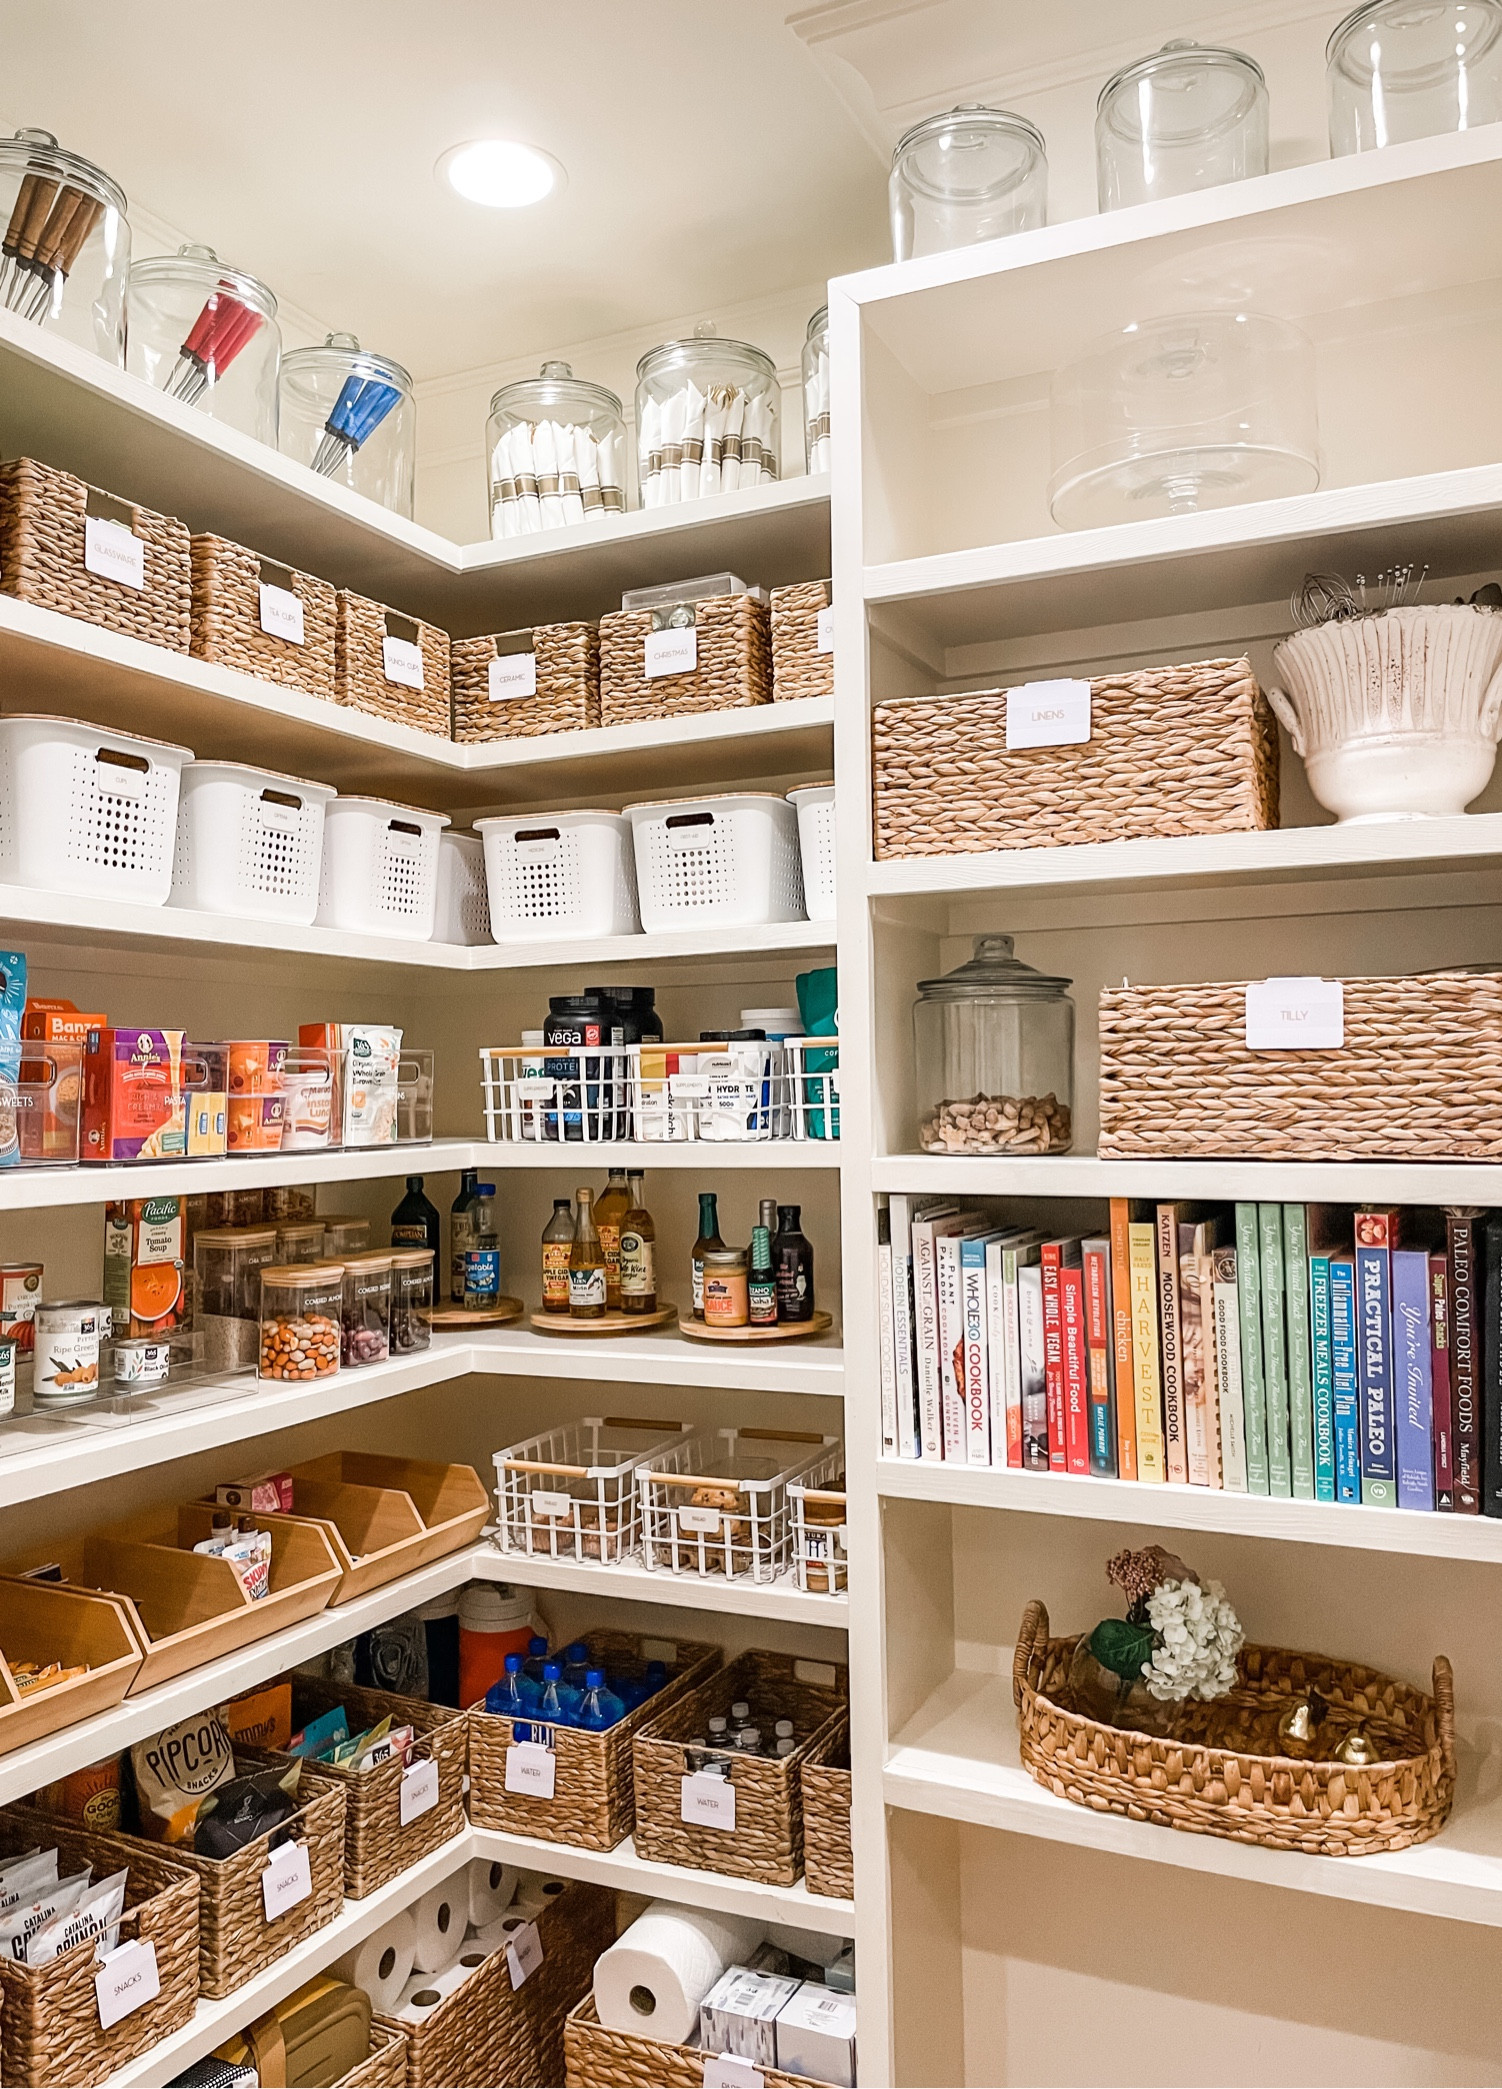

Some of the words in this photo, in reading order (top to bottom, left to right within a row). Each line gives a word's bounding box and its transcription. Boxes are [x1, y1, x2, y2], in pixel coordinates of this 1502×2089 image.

[94, 543, 137, 568] GLASSWARE
[269, 606, 280, 617] TEA
[281, 612, 296, 624] CUPS
[387, 656, 405, 668] PUNCH
[407, 662, 420, 673] CUPS
[653, 648, 689, 660] CHRISTMAS
[499, 673, 526, 684] CERAMIC
[1031, 709, 1065, 722] LINENS
[1280, 1010, 1309, 1021] TILLY
[131, 1053, 161, 1063] Annie's
[546, 1062, 578, 1072] PROTEI
[164, 1096, 187, 1106] PASTA
[144, 1201, 177, 1217] Pacific
[146, 1237, 172, 1246] Tomato
[149, 1244, 168, 1253] Soup
[1116, 1223, 1125, 1270] HOMESTYLE
[1161, 1214, 1171, 1258] KATZEN
[1239, 1223, 1254, 1255] You're
[1262, 1223, 1277, 1255] You're
[1288, 1224, 1302, 1255] You're
[466, 1263, 494, 1272] getable
[920, 1238, 932, 1298] AGAINST
[1453, 1228, 1469, 1282] PALEO
[880, 1252, 889, 1300] HOLIDAY
[895, 1256, 905, 1307] MODERN
[939, 1246, 947, 1305] PARADOX
[1044, 1265, 1058, 1291] EASY.
[1090, 1256, 1099, 1297] METABOLISM
[1243, 1254, 1255, 1290] Invited
[1266, 1255, 1278, 1290] Invited
[1291, 1256, 1303, 1291] Invited
[1433, 1273, 1444, 1297] Super
[881, 1302, 890, 1334] SLOW
[967, 1273, 981, 1341] WHOLE30
[1045, 1294, 1059, 1328] WHOLE.
[1064, 1284, 1077, 1324] Simple
[1092, 1298, 1101, 1338] REVOLUTION
[1163, 1272, 1176, 1361] MOOSEWOOD
[1244, 1292, 1256, 1318] Back
[1268, 1292, 1279, 1319] Back
[1293, 1293, 1304, 1320] Back
[1314, 1277, 1329, 1336] FREEZER
[1364, 1259, 1383, 1378] PRACTICAL
[1434, 1298, 1445, 1320] Paleo
[897, 1310, 908, 1375] ESSENTIALS
[922, 1306, 934, 1350] GRAIN
[1117, 1310, 1132, 1362] chicken
[1399, 1302, 1422, 1360] You're
[1435, 1321, 1446, 1349] Snacks
[1455, 1286, 1472, 1372] COMFORT
[53, 1345, 72, 1354] Ripe
[74, 1343, 95, 1352] Green
[882, 1336, 892, 1383] COOKER
[1047, 1333, 1061, 1366] VEGAN.
[1067, 1327, 1080, 1379] Beautiful
[1137, 1276, 1154, 1424] HARVEST
[1316, 1339, 1330, 1385] MEALS
[924, 1357, 933, 1395] Danielle
[969, 1343, 983, 1431] COOKBOOK
[1220, 1348, 1229, 1394] COOKBOOK
[1335, 1371, 1354, 1391] Diet
[1070, 1382, 1081, 1412] Food
[1166, 1365, 1179, 1443] COOKBOOK
[1336, 1395, 1355, 1416] Plan
[1406, 1360, 1425, 1431] Invited
[1457, 1376, 1473, 1433] FOODS
[926, 1398, 935, 1432] Walker
[1317, 1387, 1332, 1466] COOKBOOK
[1367, 1386, 1386, 1455] PALEO
[1458, 1442, 1470, 1485] Mayfield
[186, 1766, 219, 1790] SNACKS
[520, 1766, 541, 1777] WATER
[696, 1796, 720, 1810] WATER
[276, 1873, 299, 1892] SNACKS
[1, 1892, 20, 1908] ALINA
[24, 1906, 56, 1930] CATALINA
[64, 1913, 94, 1938] CATALINA
[113, 1972, 142, 1996] SNACKS
